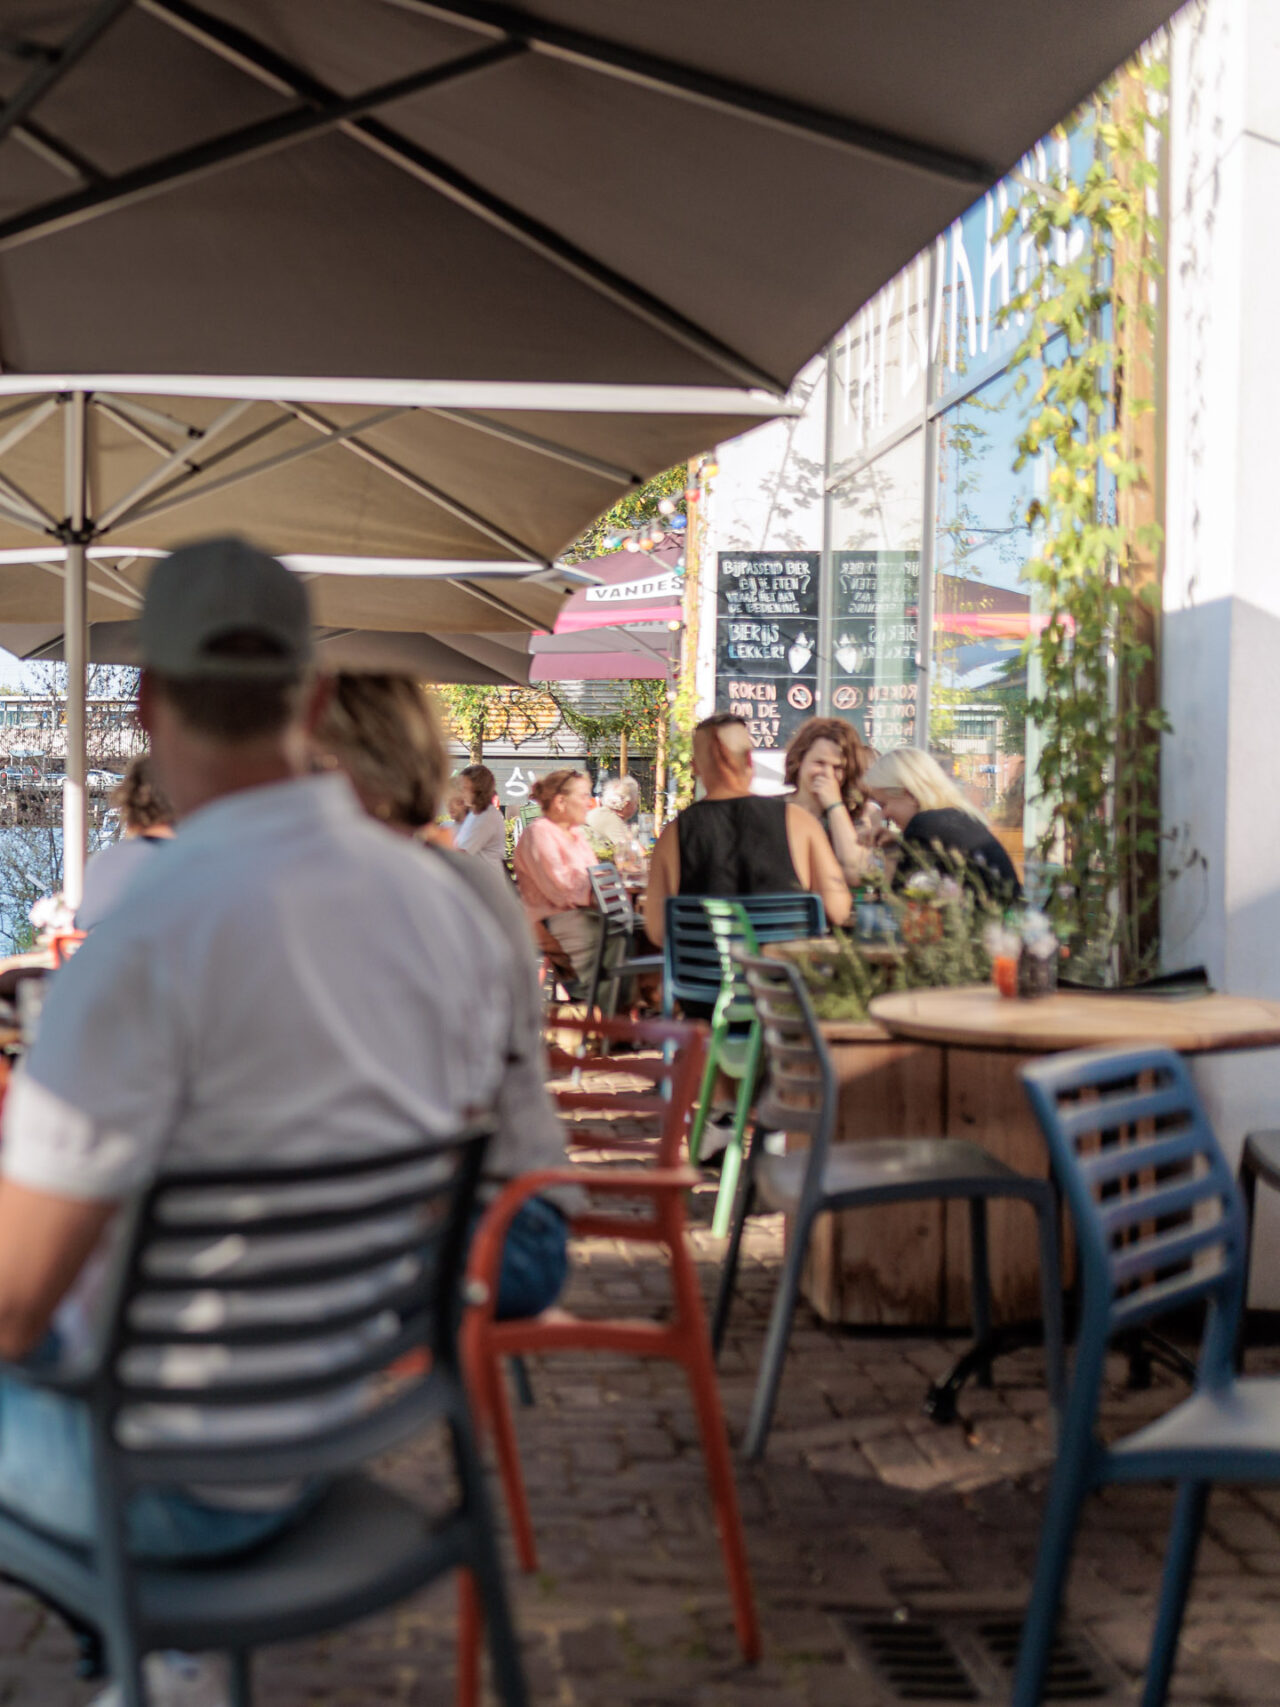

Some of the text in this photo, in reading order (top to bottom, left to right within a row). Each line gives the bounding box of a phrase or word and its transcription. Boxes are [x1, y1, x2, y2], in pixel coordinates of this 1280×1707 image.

[785, 560, 810, 575] BIER
[728, 645, 785, 659] LEKKER!
[729, 681, 776, 701] ROKEN
[758, 704, 781, 718] DE
